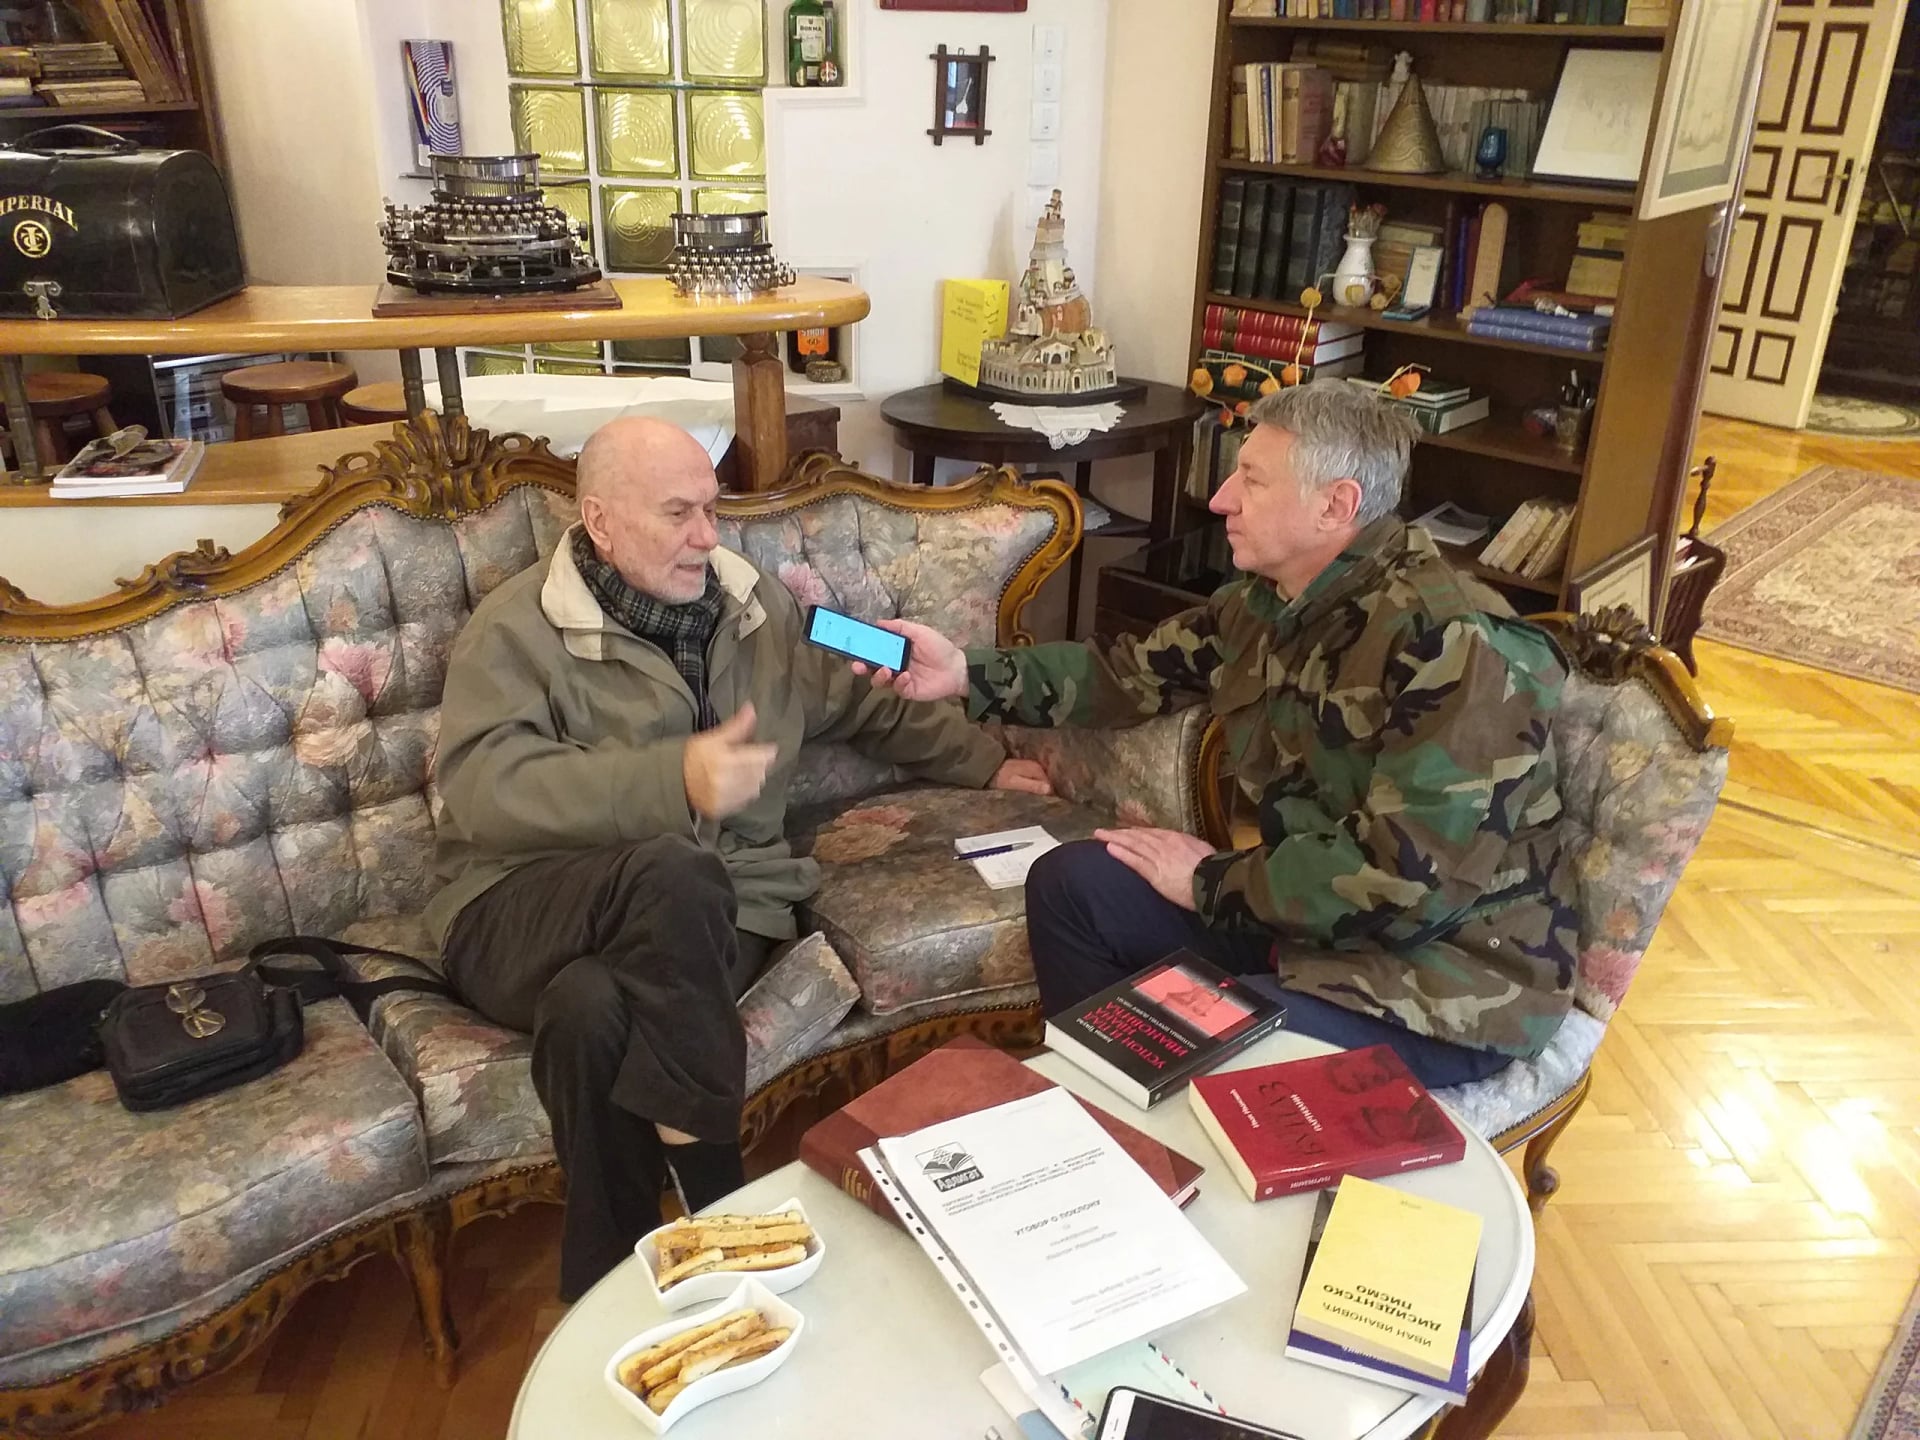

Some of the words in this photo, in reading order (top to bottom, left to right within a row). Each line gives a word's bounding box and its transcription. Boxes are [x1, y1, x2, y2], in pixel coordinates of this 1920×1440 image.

[1323, 1284, 1442, 1332] ДИСИДЕНТСКО
[1356, 1285, 1413, 1310] ПИСМО
[1322, 1302, 1393, 1333] ИВАНОВИЋ
[1396, 1329, 1432, 1347] ИВАН
